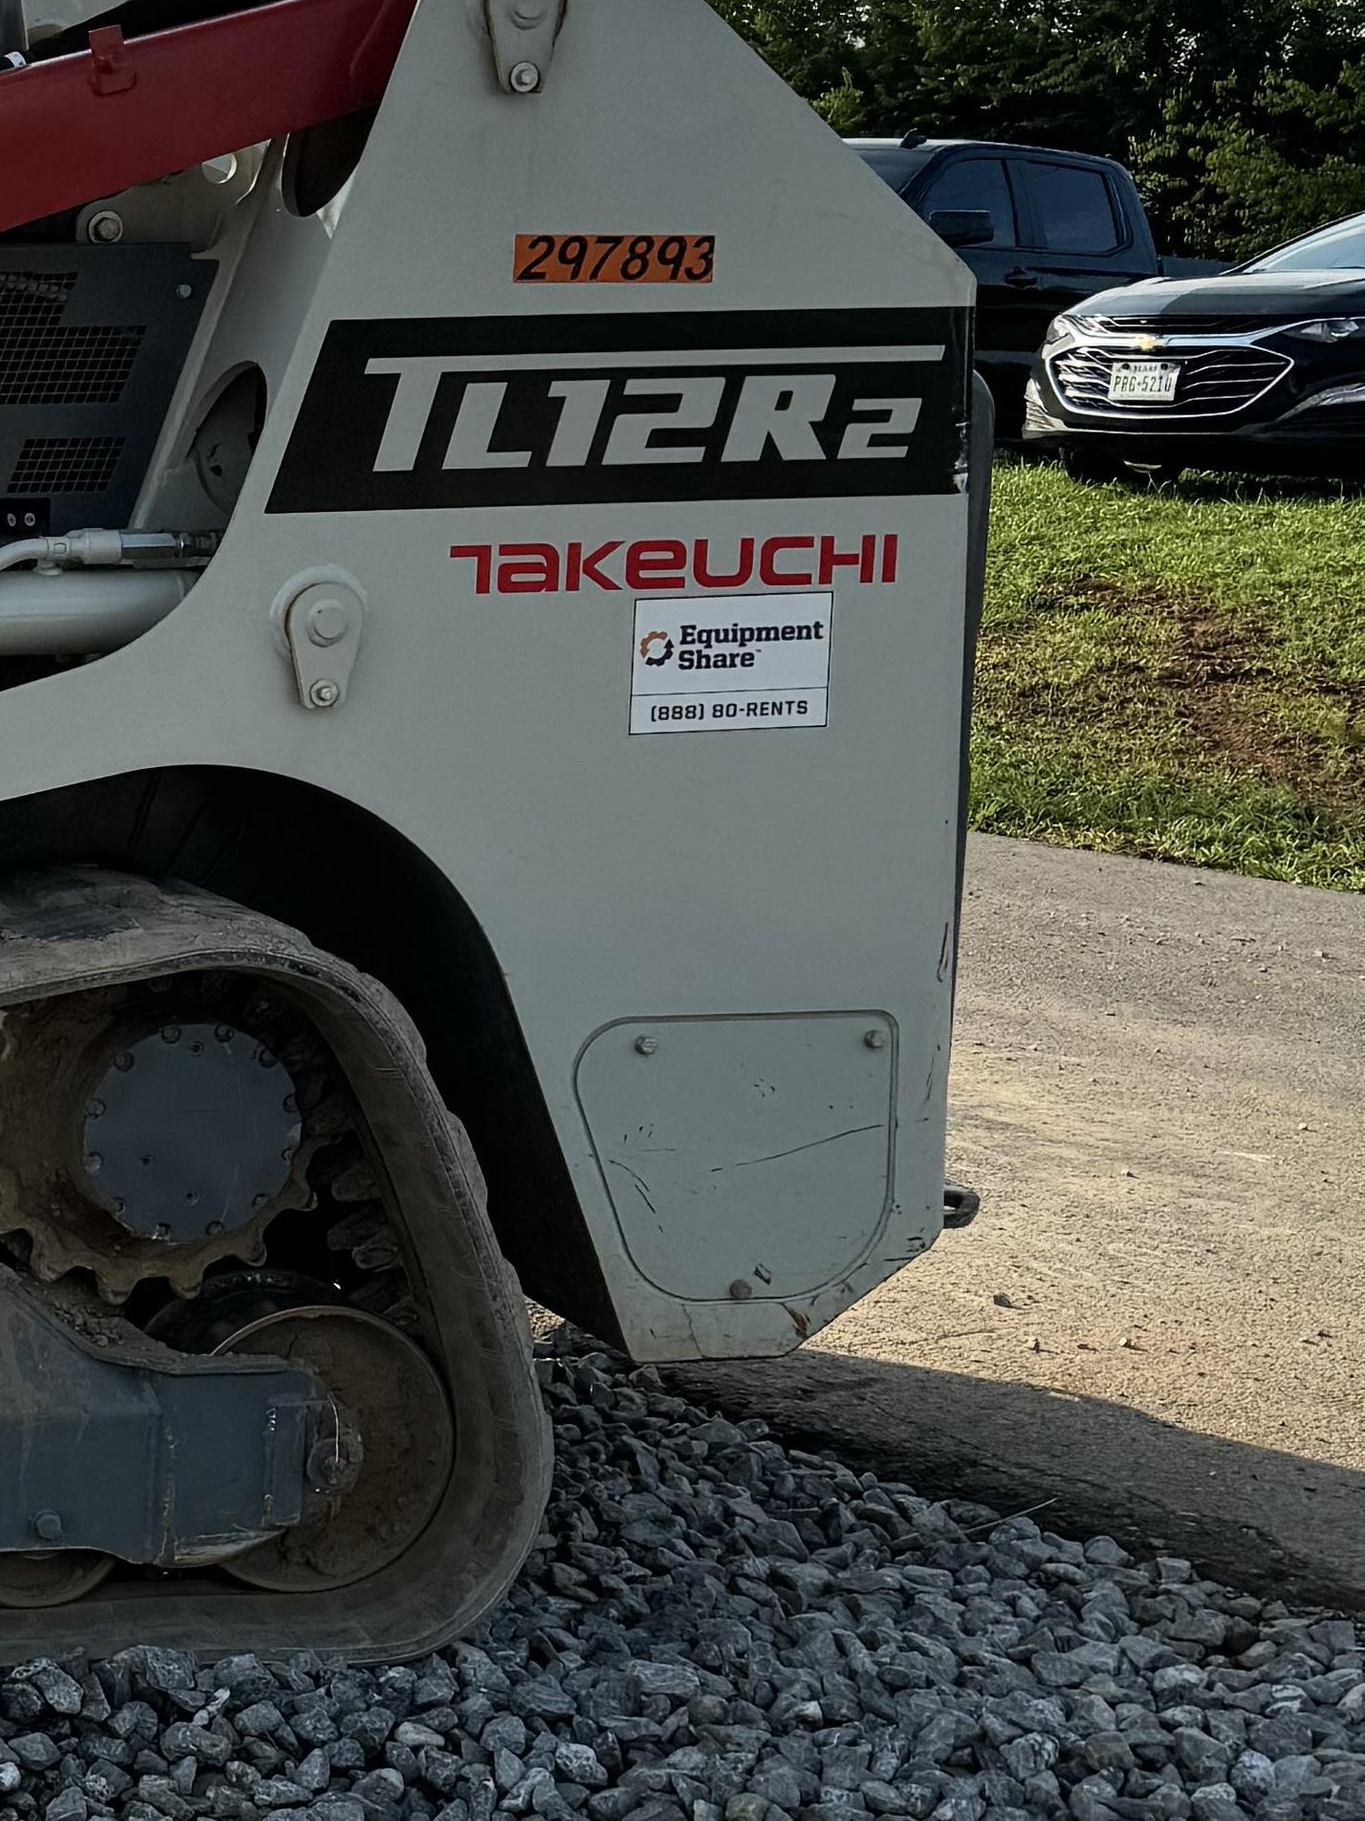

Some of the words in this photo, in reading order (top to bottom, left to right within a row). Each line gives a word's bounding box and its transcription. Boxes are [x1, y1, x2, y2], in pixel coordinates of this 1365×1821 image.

[516, 235, 715, 281] 297893
[450, 534, 898, 594] TAKEUCHI
[679, 621, 824, 649] Equipment
[678, 649, 755, 670] Share
[651, 703, 705, 723] (888)
[712, 700, 809, 718] 80-RENTS
